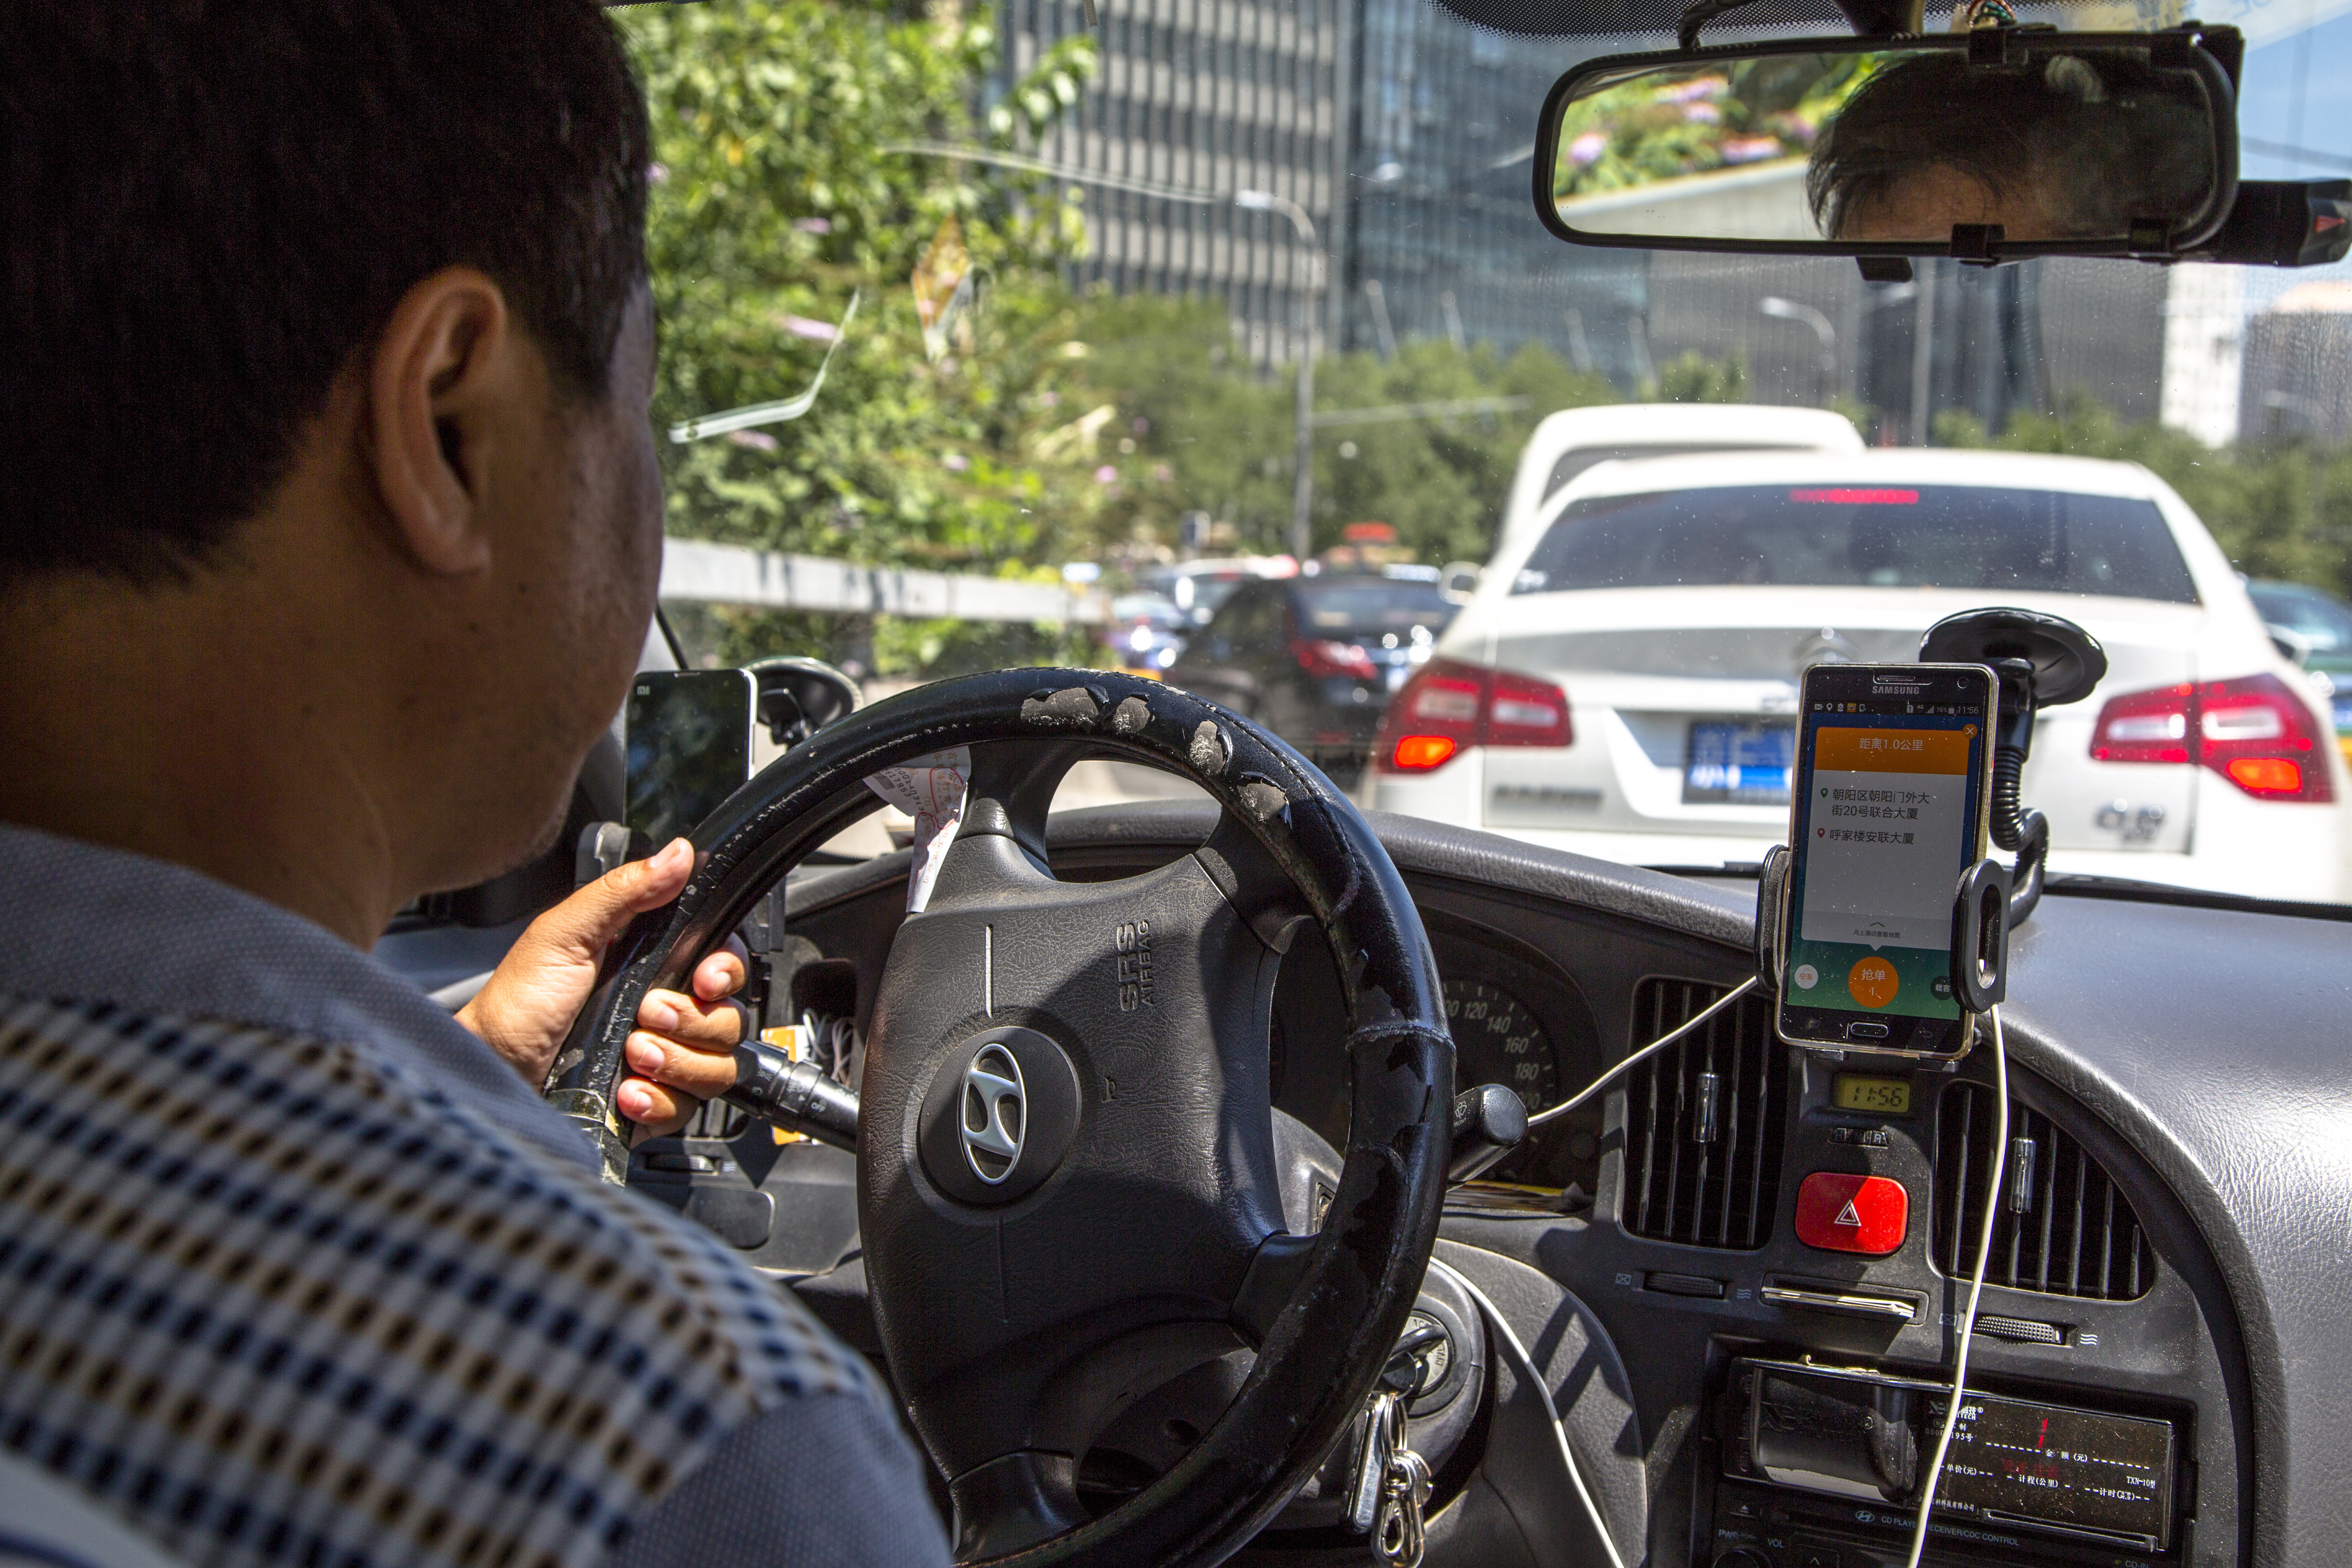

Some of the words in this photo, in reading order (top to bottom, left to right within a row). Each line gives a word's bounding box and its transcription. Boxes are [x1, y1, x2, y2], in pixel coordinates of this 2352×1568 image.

[1873, 686, 1920, 695] SAMSUNG
[1859, 738, 1923, 751] 距离1.0公里
[1832, 788, 1930, 804] 朝阳区朝阳门外大
[1831, 804, 1919, 820] 街20号联合大厦
[1829, 829, 1915, 845] 呼家楼安联大厦
[1853, 929, 1901, 939] 向上滑动查看地图
[1117, 923, 1139, 1012] SRS
[1861, 968, 1886, 982] 抢单
[1799, 972, 1814, 981] 空车
[1935, 984, 1951, 993] 载客
[1465, 1001, 1488, 1020] 120
[1486, 1015, 1512, 1034] 140
[1506, 1036, 1530, 1054] 160
[1514, 1062, 1540, 1081] 180
[2018, 1474, 2058, 1488] 计程(公里)
[1894, 1518, 1917, 1528] PLAYE
[1981, 1533, 2020, 1546] CONTROL
[1767, 1538, 1785, 1549] VOL
